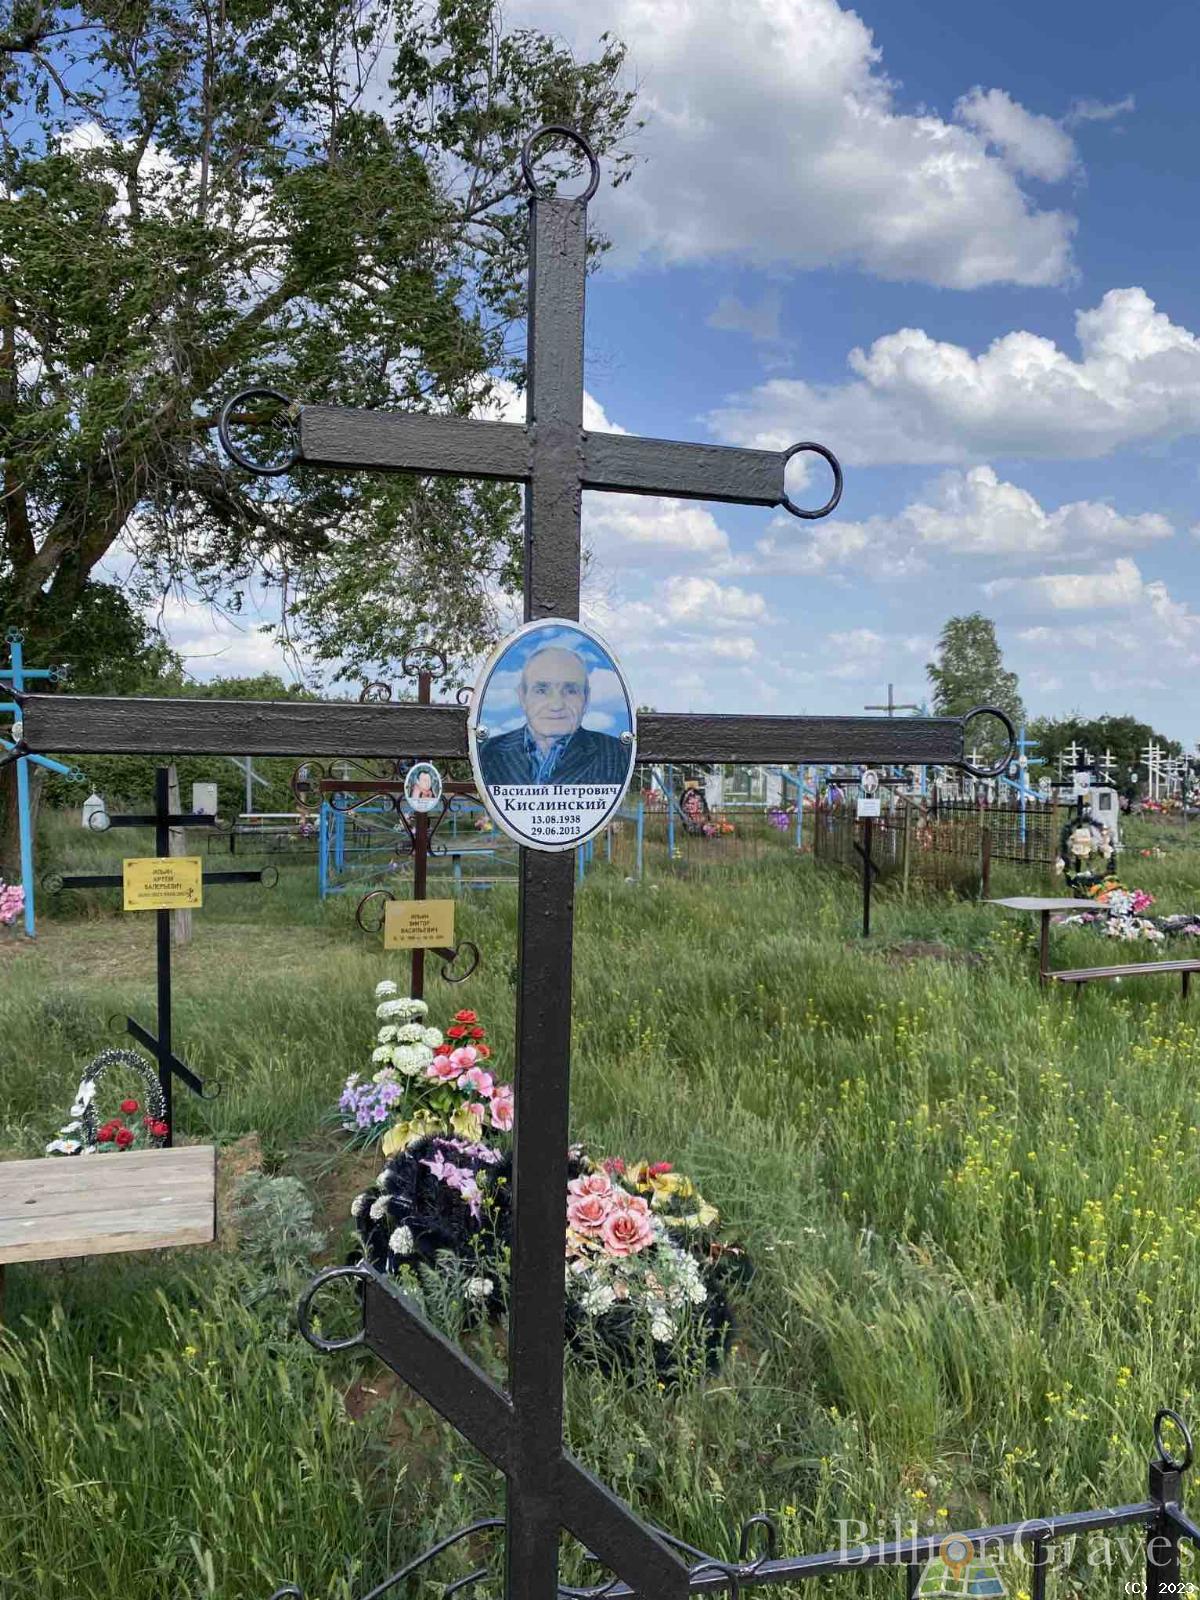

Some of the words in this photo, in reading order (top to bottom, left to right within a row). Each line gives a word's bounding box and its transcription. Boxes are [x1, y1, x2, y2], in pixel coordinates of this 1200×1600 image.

[493, 785, 549, 796] Василий
[553, 785, 618, 798] Петрович
[504, 798, 607, 811] Кислинский
[531, 815, 581, 824] 13.08.1938
[531, 827, 581, 836] 29.06.2013
